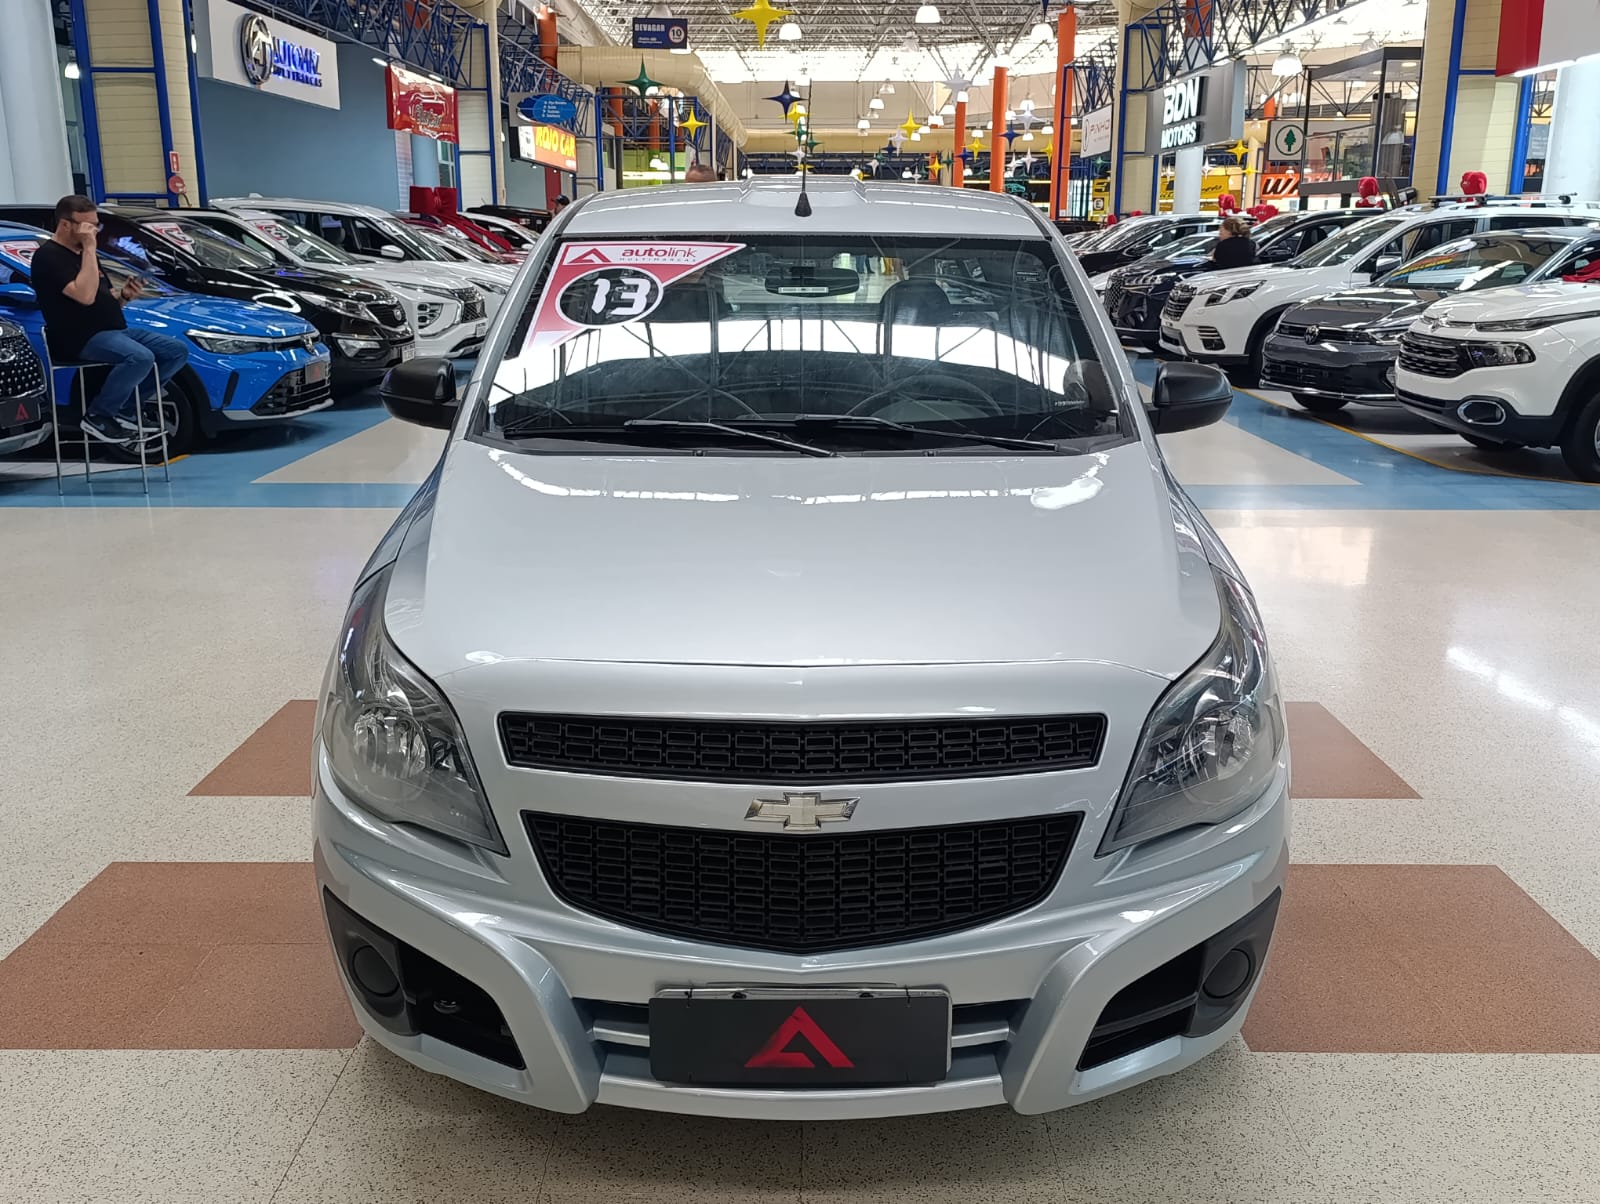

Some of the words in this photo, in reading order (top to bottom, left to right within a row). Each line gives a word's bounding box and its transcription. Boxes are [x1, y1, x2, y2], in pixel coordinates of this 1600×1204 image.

[634, 23, 665, 32] DEVAGAR
[671, 28, 682, 37] 10
[1163, 77, 1200, 124] BDN
[536, 126, 559, 152] ROJO
[1161, 121, 1197, 149] MOTORS
[621, 247, 698, 258] autolink
[591, 278, 652, 316] 13
